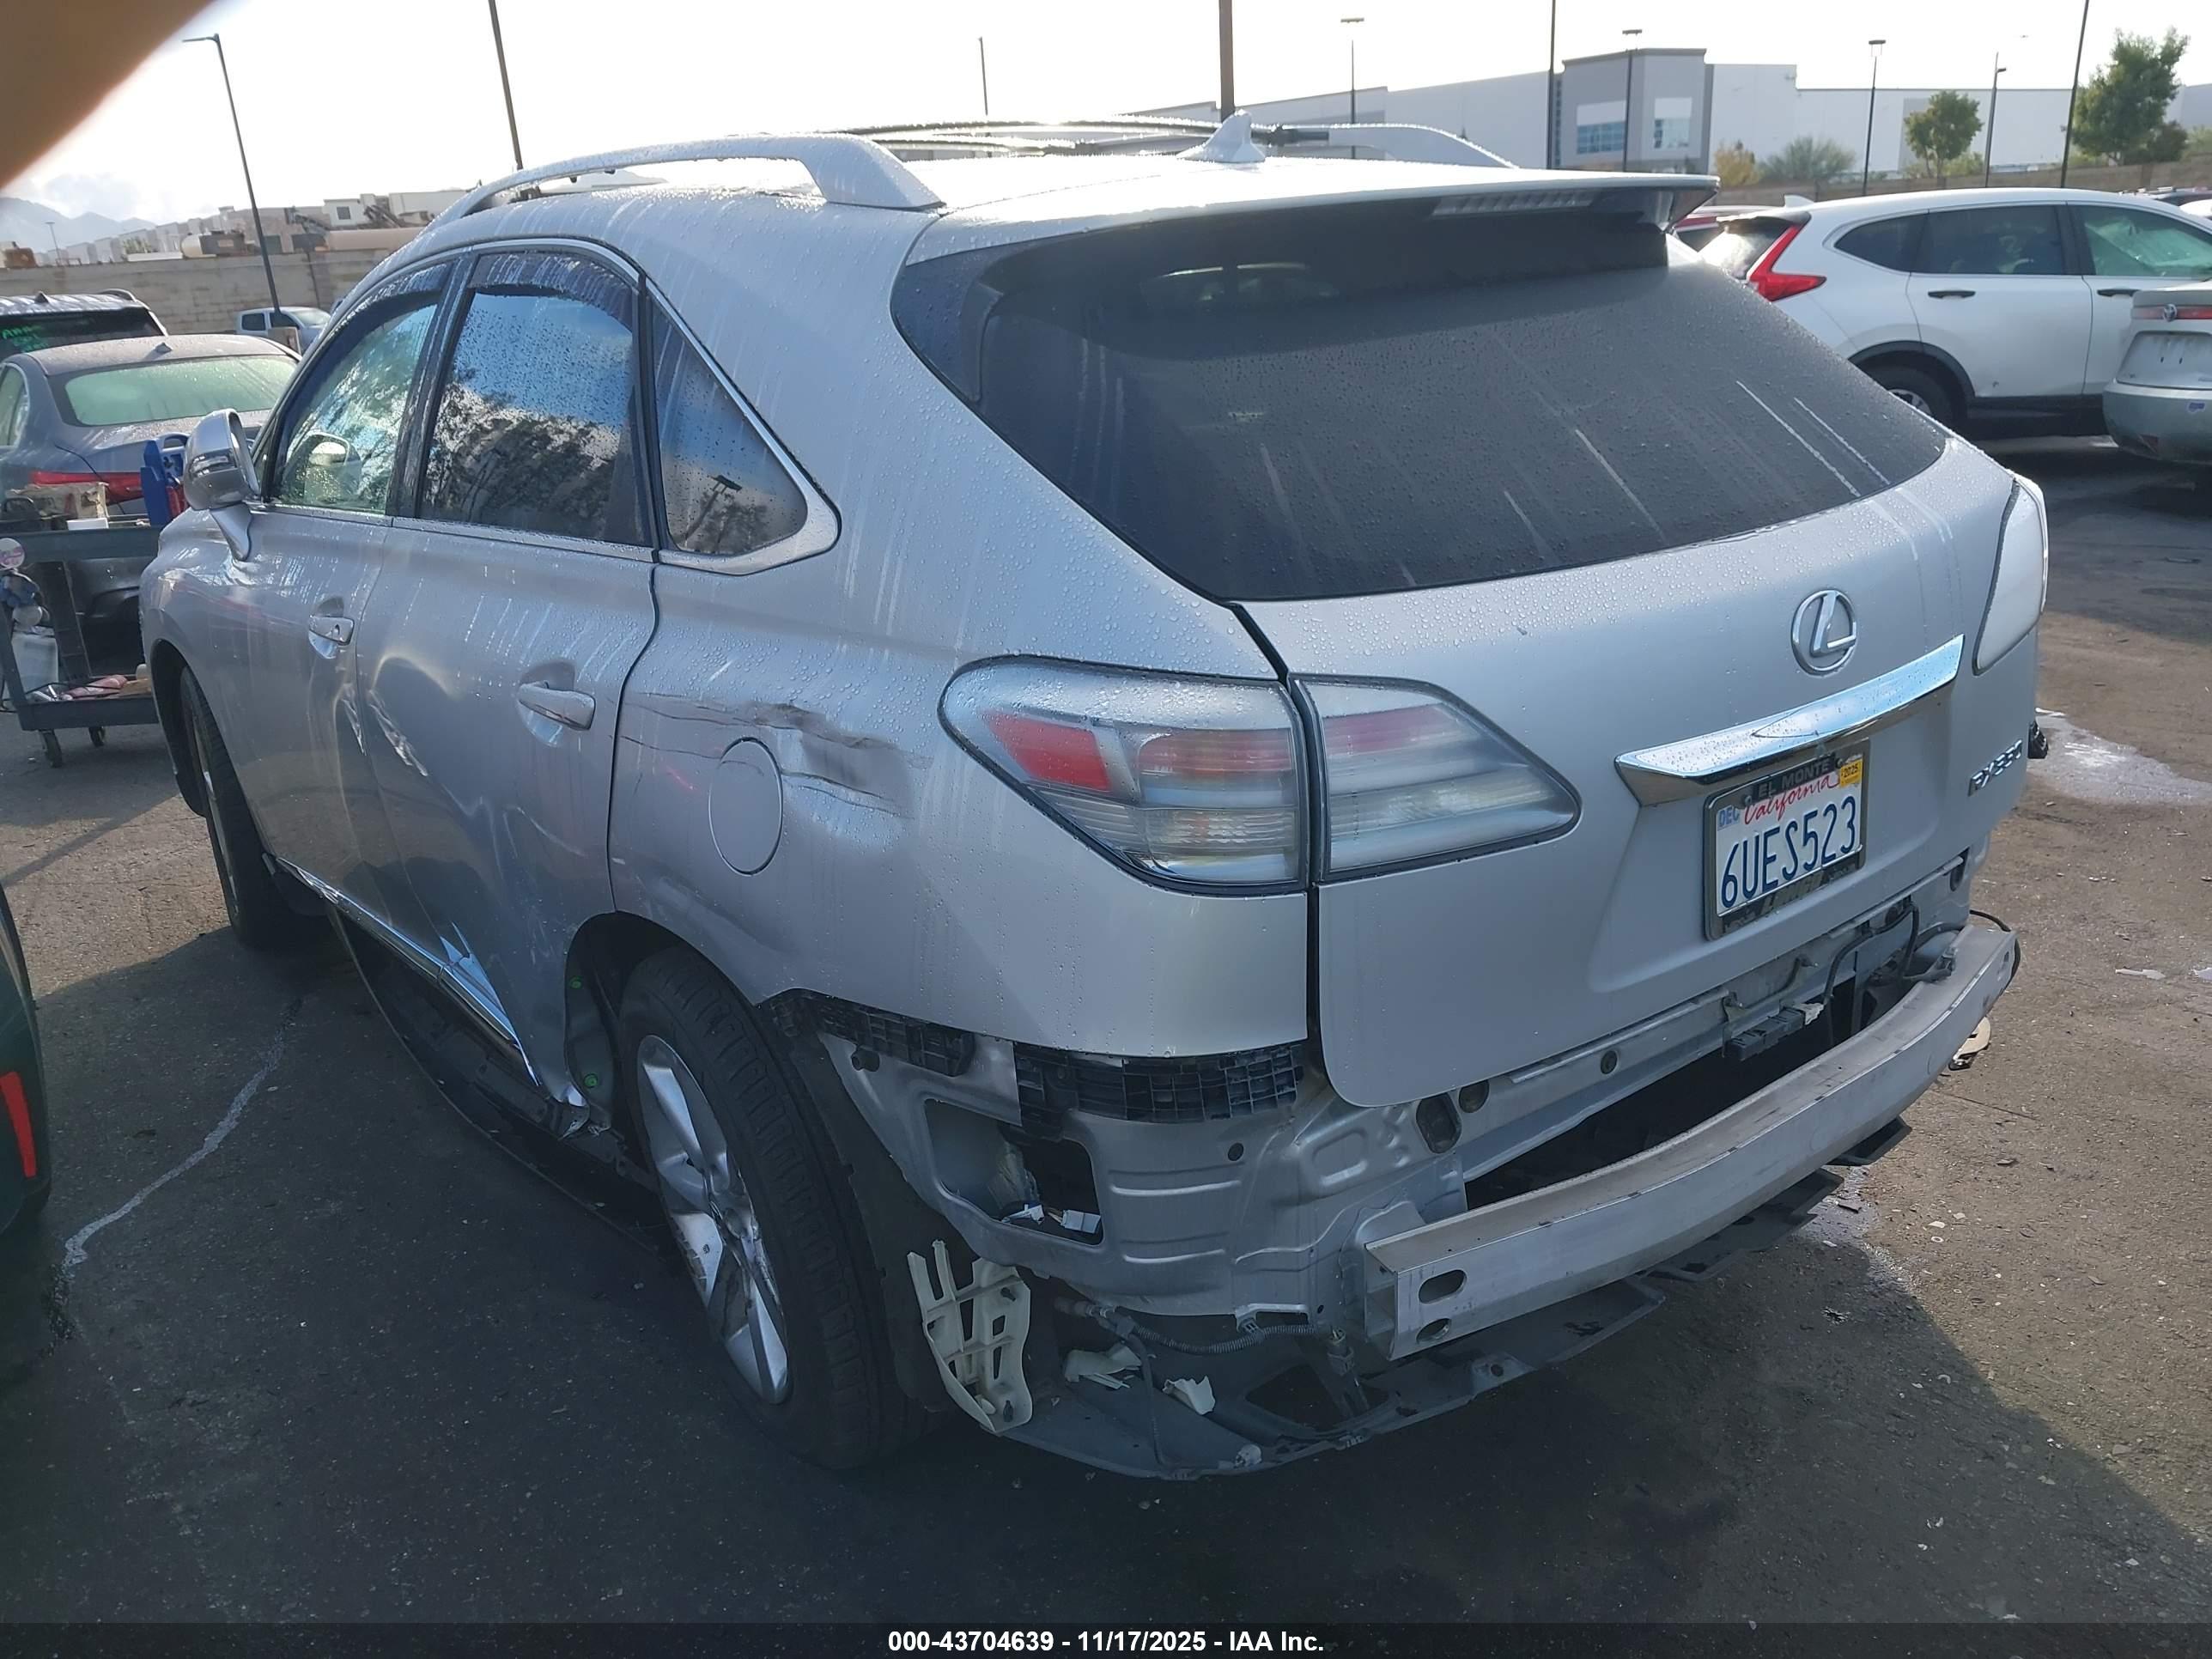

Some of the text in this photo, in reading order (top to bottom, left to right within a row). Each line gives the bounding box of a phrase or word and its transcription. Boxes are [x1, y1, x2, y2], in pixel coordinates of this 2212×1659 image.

[1743, 775, 1840, 824] California
[1759, 758, 1830, 798] EL MONTE
[1719, 805, 1740, 828] DEC
[1721, 795, 1856, 908] 6UES523
